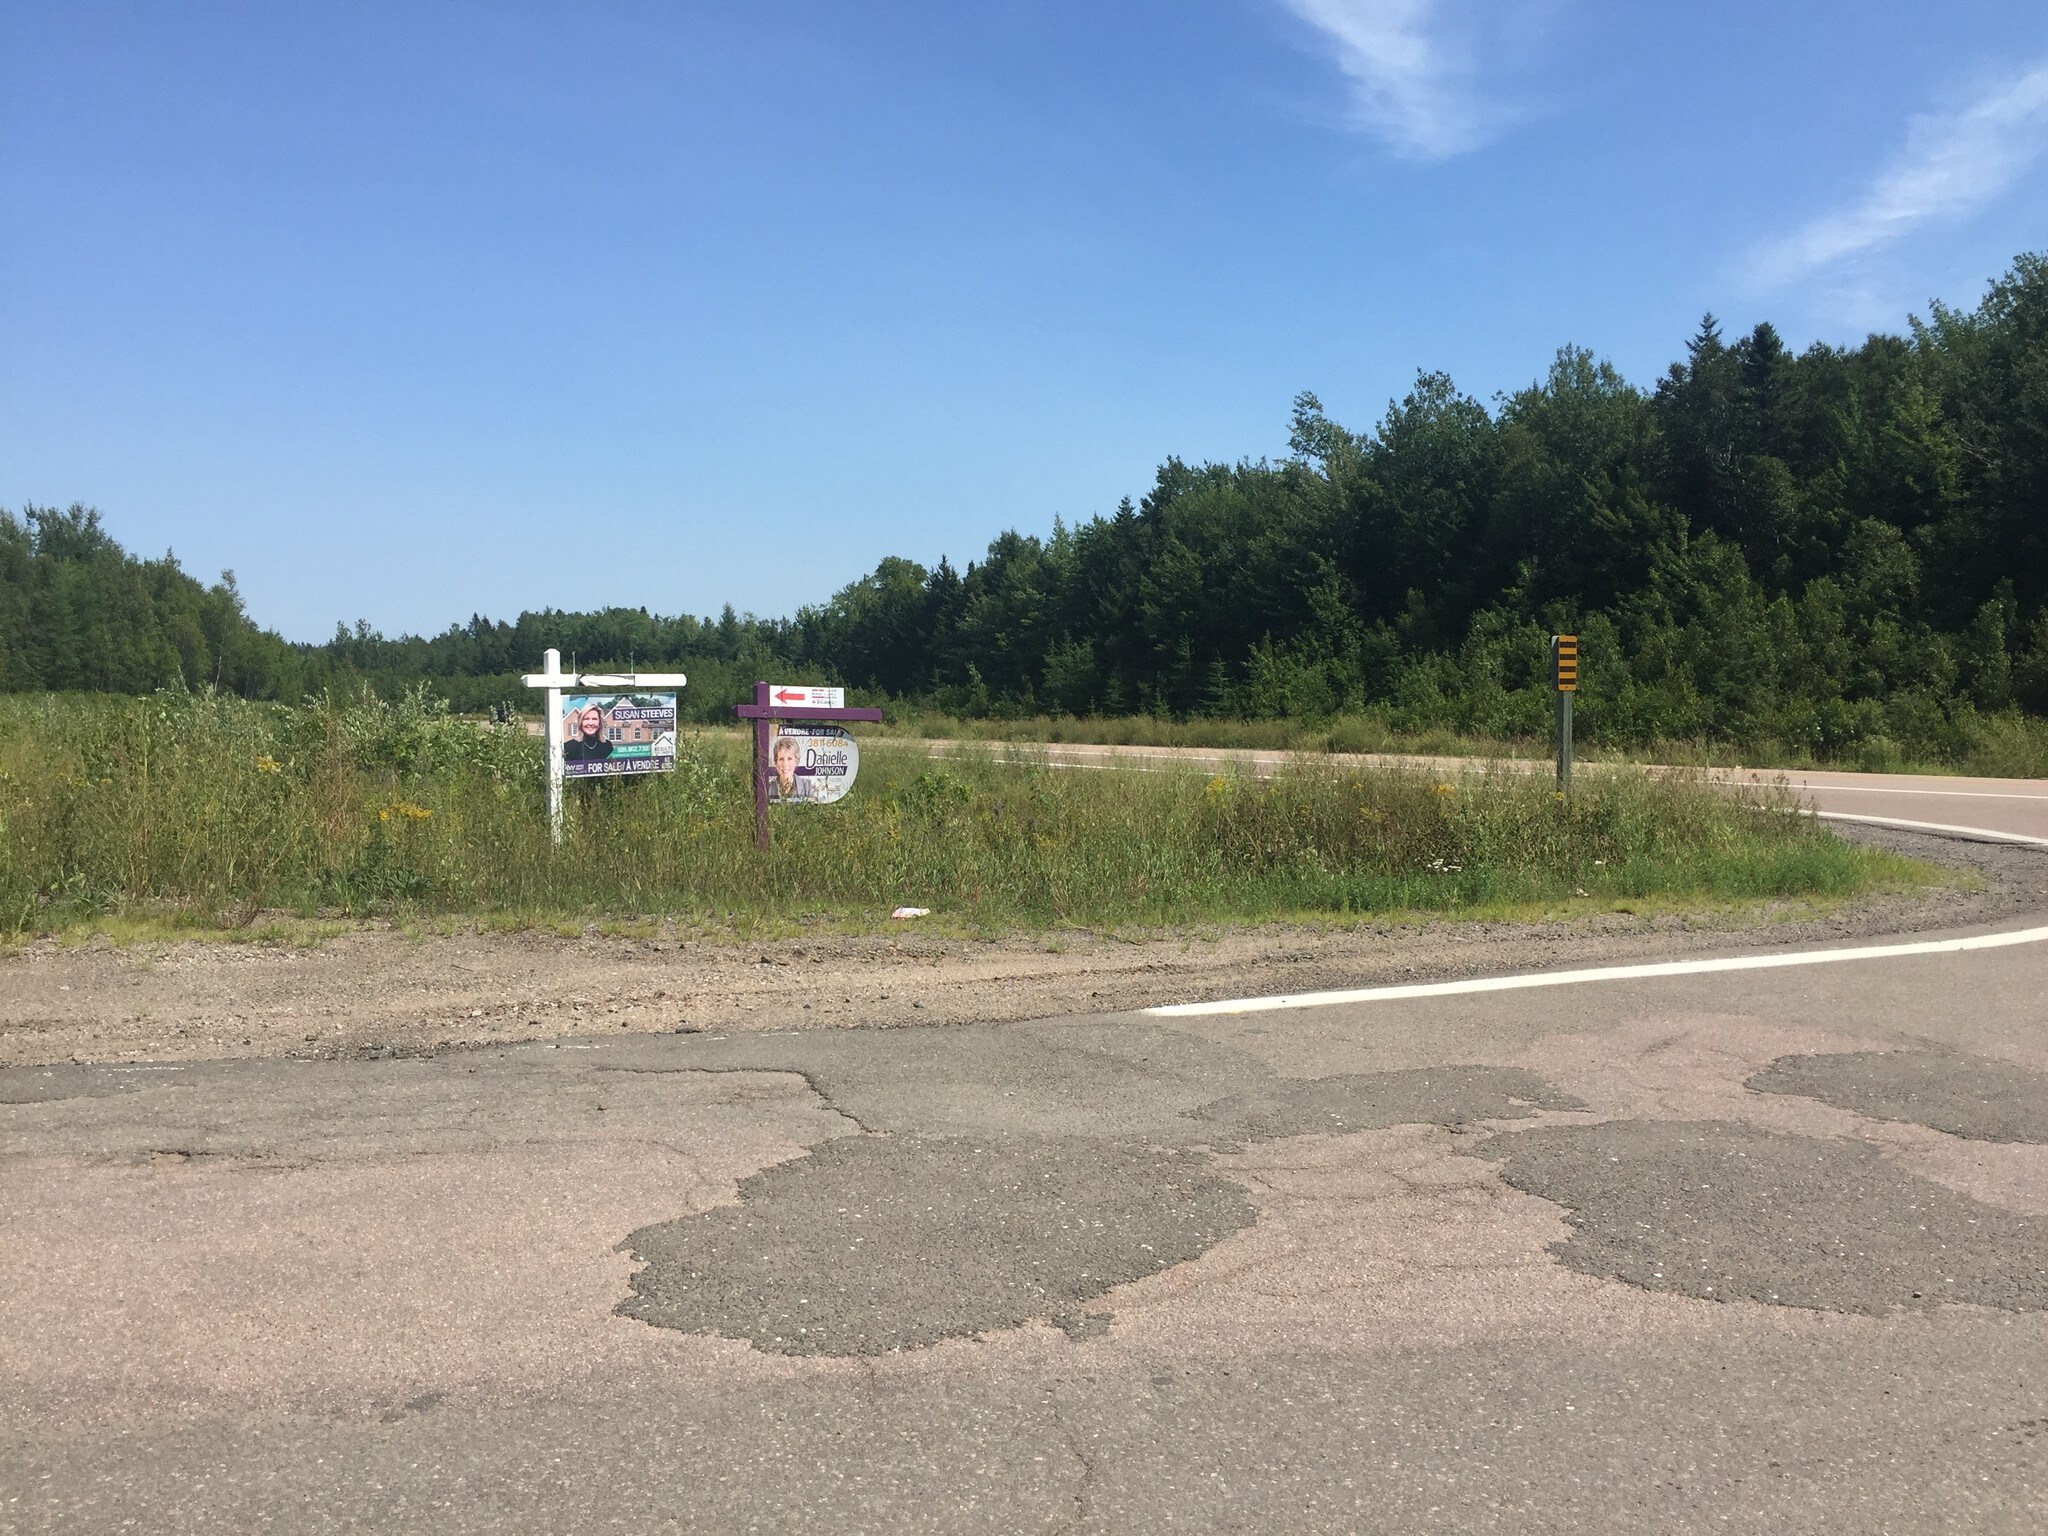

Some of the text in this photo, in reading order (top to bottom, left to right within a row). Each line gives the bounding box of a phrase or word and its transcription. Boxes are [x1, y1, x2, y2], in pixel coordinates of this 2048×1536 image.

[614, 708, 673, 720] SUSAN STEEVES
[784, 728, 810, 736] VENDRE
[812, 728, 825, 736] FOR
[806, 748, 848, 769] Danielle
[587, 763, 603, 773] FOR
[603, 762, 621, 772] SALE
[633, 760, 660, 771] VENDRE
[815, 766, 845, 776] JOHNSON
